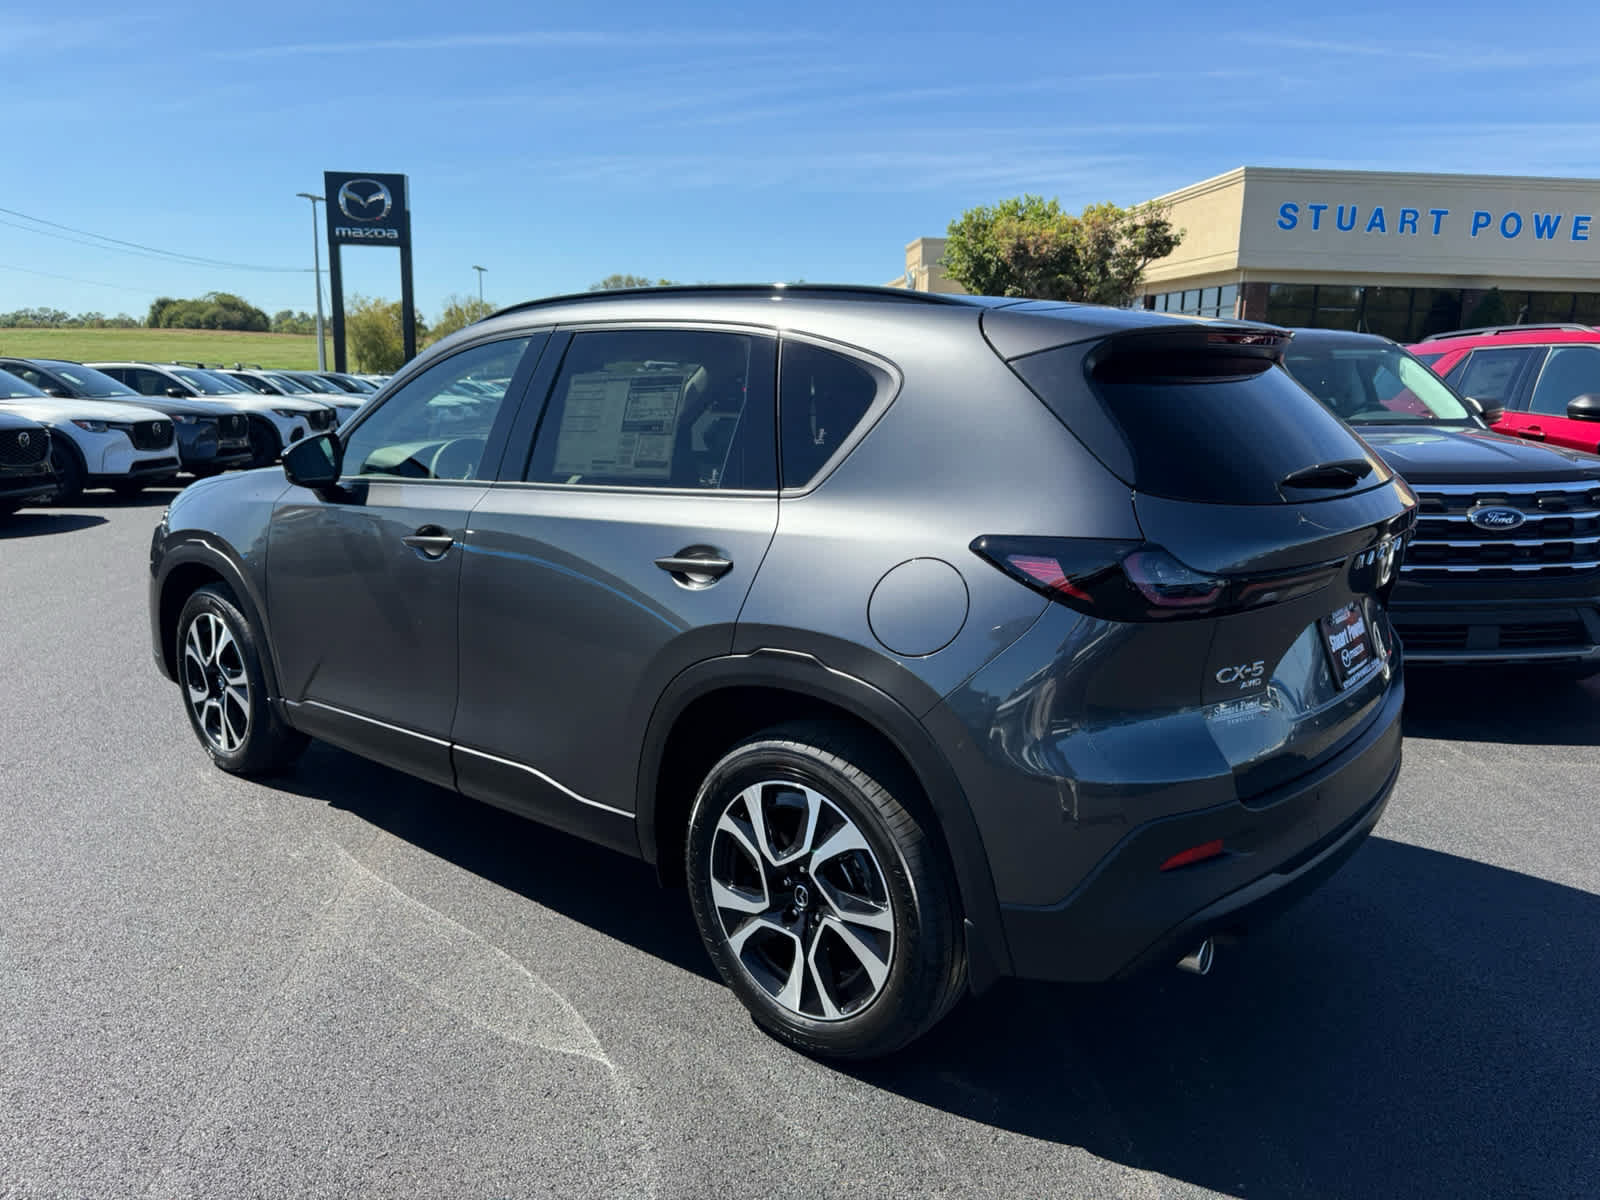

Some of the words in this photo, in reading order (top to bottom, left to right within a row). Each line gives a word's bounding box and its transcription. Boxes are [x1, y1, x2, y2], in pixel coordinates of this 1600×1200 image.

[1276, 202, 1449, 236] STUART
[1470, 210, 1593, 241] POWE
[335, 227, 399, 239] mazda
[1484, 511, 1514, 524] Ford
[1215, 660, 1265, 684] CX-5
